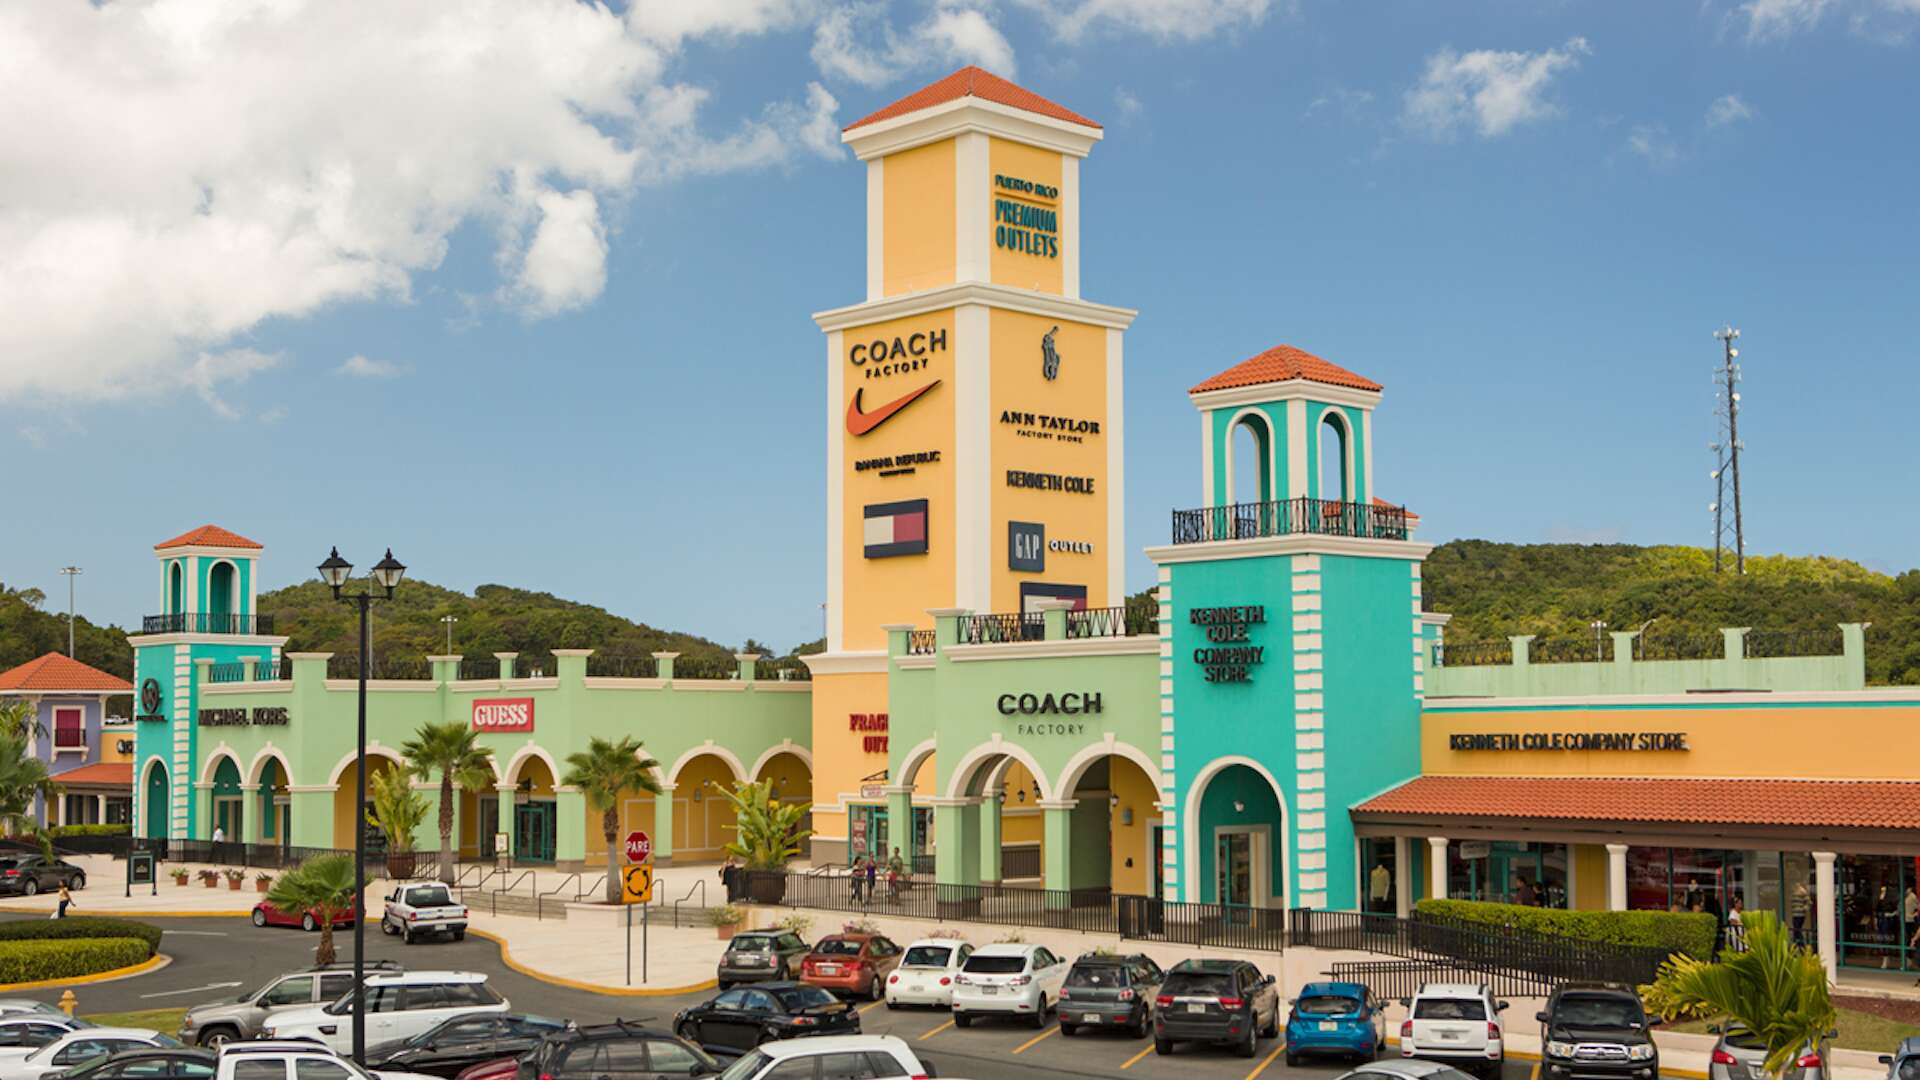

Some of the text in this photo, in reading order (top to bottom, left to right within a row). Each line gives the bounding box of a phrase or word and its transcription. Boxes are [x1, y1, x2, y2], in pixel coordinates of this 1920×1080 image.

[995, 174, 1058, 199] PUERTO RICO
[995, 199, 1057, 233] PREMIUM
[995, 225, 1058, 258] OUTLETS
[850, 328, 946, 366] COACH
[865, 358, 928, 379] FACTORY
[1000, 410, 1100, 434] ANN TAYLOR
[1016, 429, 1083, 444] FACTORY STORE
[1006, 470, 1095, 495] KENNETH COLE
[1015, 532, 1094, 560] GAP OUTLET
[1190, 605, 1265, 625] KENNETH
[1206, 623, 1250, 643] COLE
[1193, 645, 1264, 665] COMPANY
[1204, 664, 1253, 684] STORE
[997, 692, 1102, 716] COACH
[198, 707, 289, 726] MICHAEL KORS
[474, 703, 528, 726] GUESS
[849, 713, 888, 731] FRAG
[1018, 724, 1084, 735] FACTORY
[1450, 732, 1688, 751] KENNETH COLE COMPANY STORE
[625, 840, 649, 853] PARE
